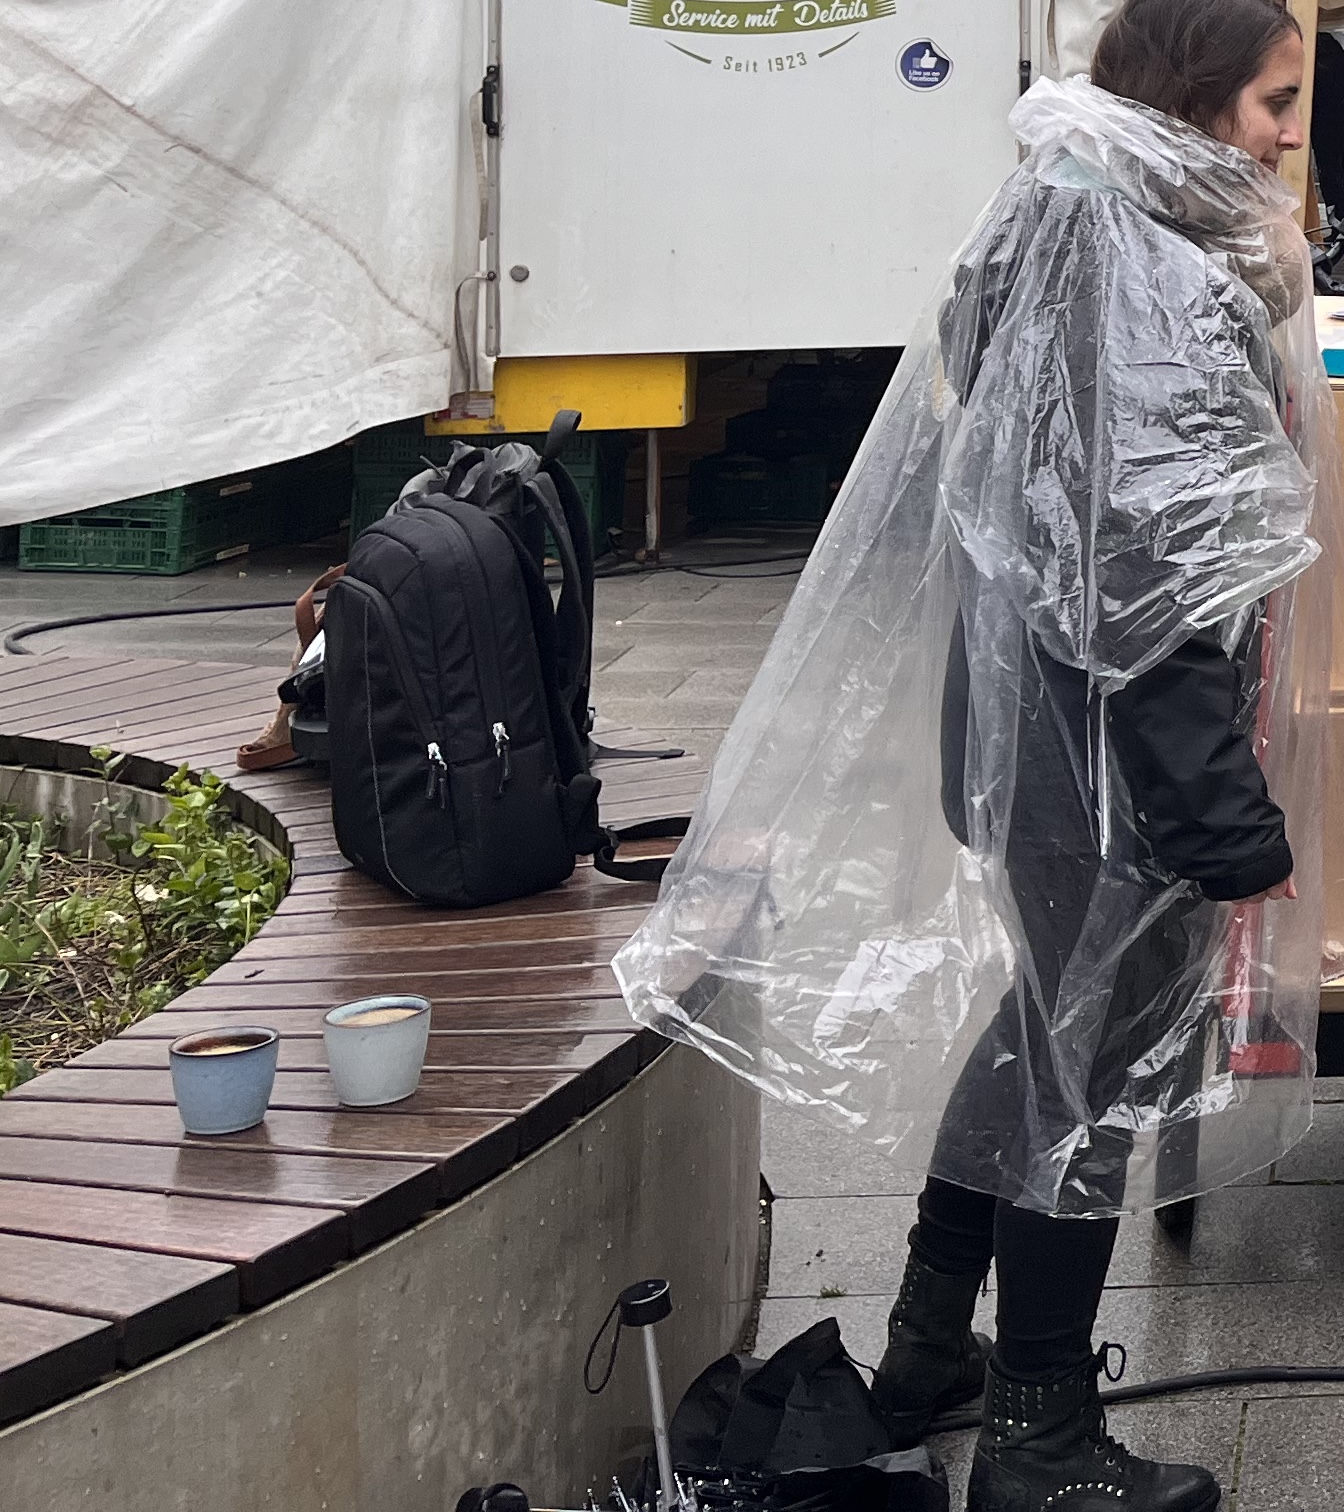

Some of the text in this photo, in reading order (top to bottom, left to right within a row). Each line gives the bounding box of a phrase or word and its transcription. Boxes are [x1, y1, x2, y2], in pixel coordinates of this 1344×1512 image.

[662, 0, 740, 29] Service
[743, 4, 785, 29] mit
[722, 51, 809, 73] Seit 1923
